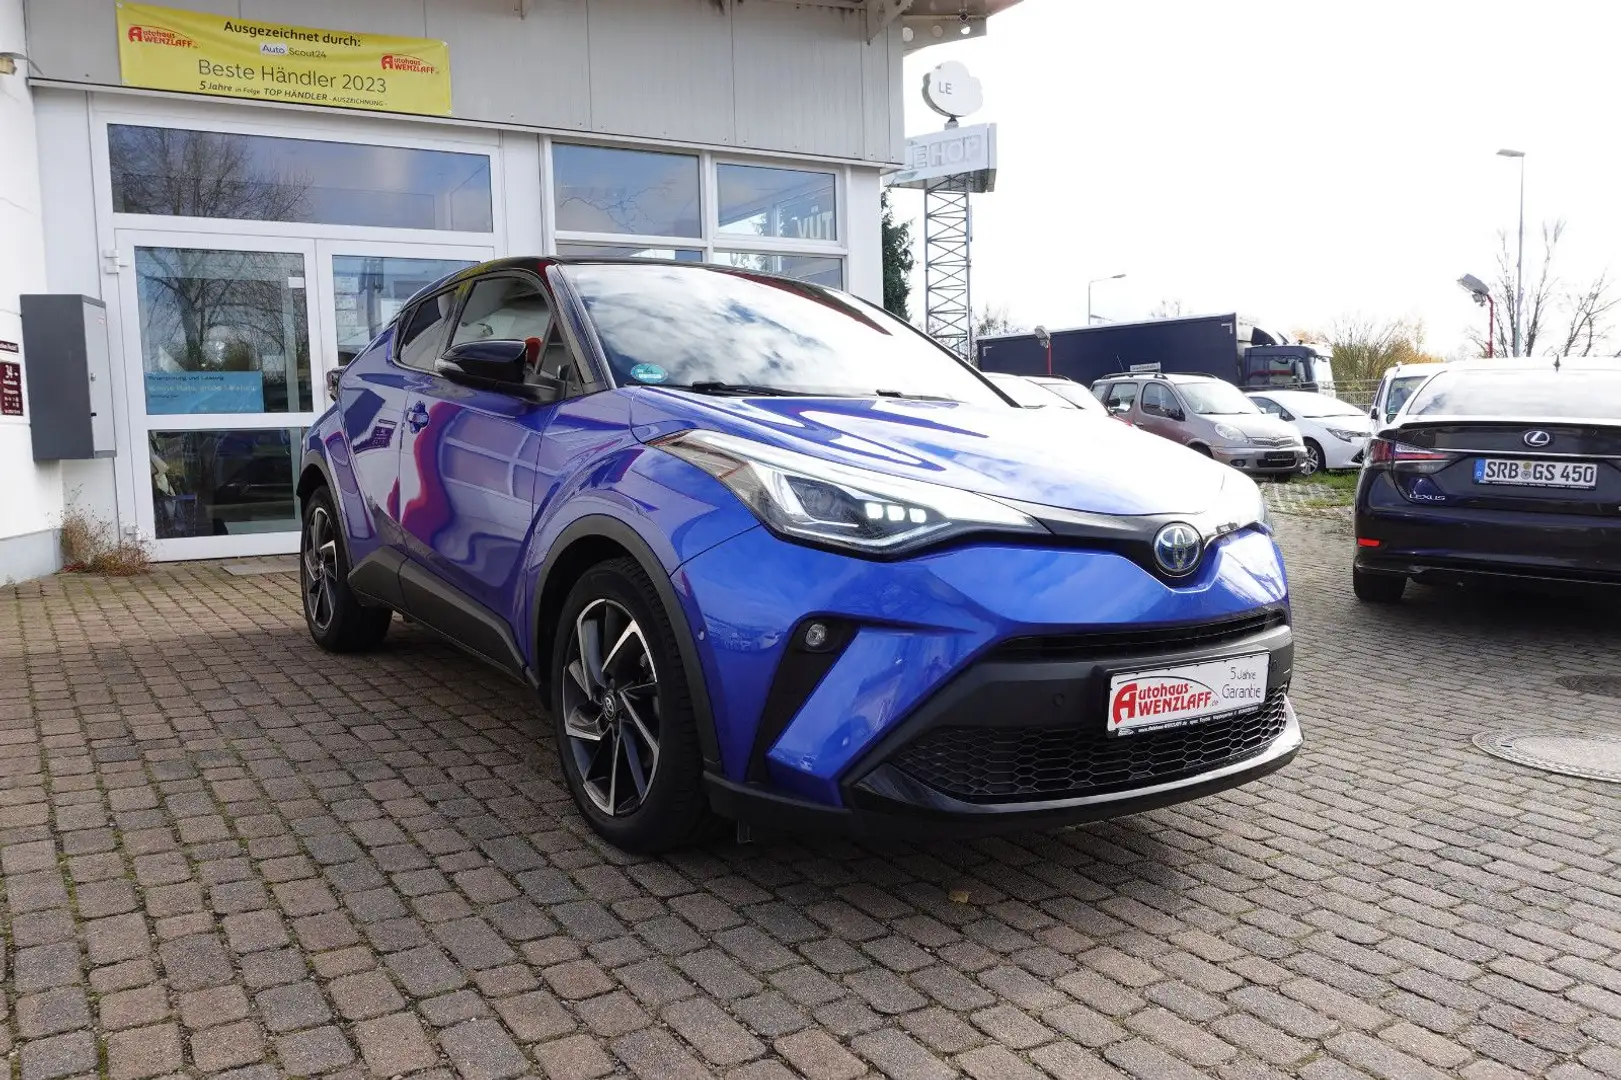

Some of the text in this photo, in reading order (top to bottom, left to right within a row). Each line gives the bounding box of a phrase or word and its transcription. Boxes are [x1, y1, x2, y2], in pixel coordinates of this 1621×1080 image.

[128, 26, 176, 43] Autohaus
[144, 35, 192, 48] WENZLAFF
[224, 21, 361, 47] Ausgezeichnet durch:
[262, 44, 327, 58] Auto Scout24
[381, 55, 421, 70] Autohaus
[394, 63, 434, 74] WENZLAFF
[198, 59, 387, 93] Beste Händler 2023
[199, 80, 206, 90] 5
[208, 82, 232, 92] Jahre
[243, 87, 261, 95] Folge
[264, 88, 282, 97] TOP
[284, 89, 328, 101] HÄNDLER
[332, 95, 384, 106] AUSZEICHNUNG
[938, 81, 952, 95] LE
[1486, 461, 1594, 483] SRB GS 450
[1410, 493, 1445, 501] LEXUS
[1230, 666, 1256, 680] 5 Jahre
[1222, 683, 1261, 699] Garantie
[1138, 691, 1212, 716] WENZLAFF
